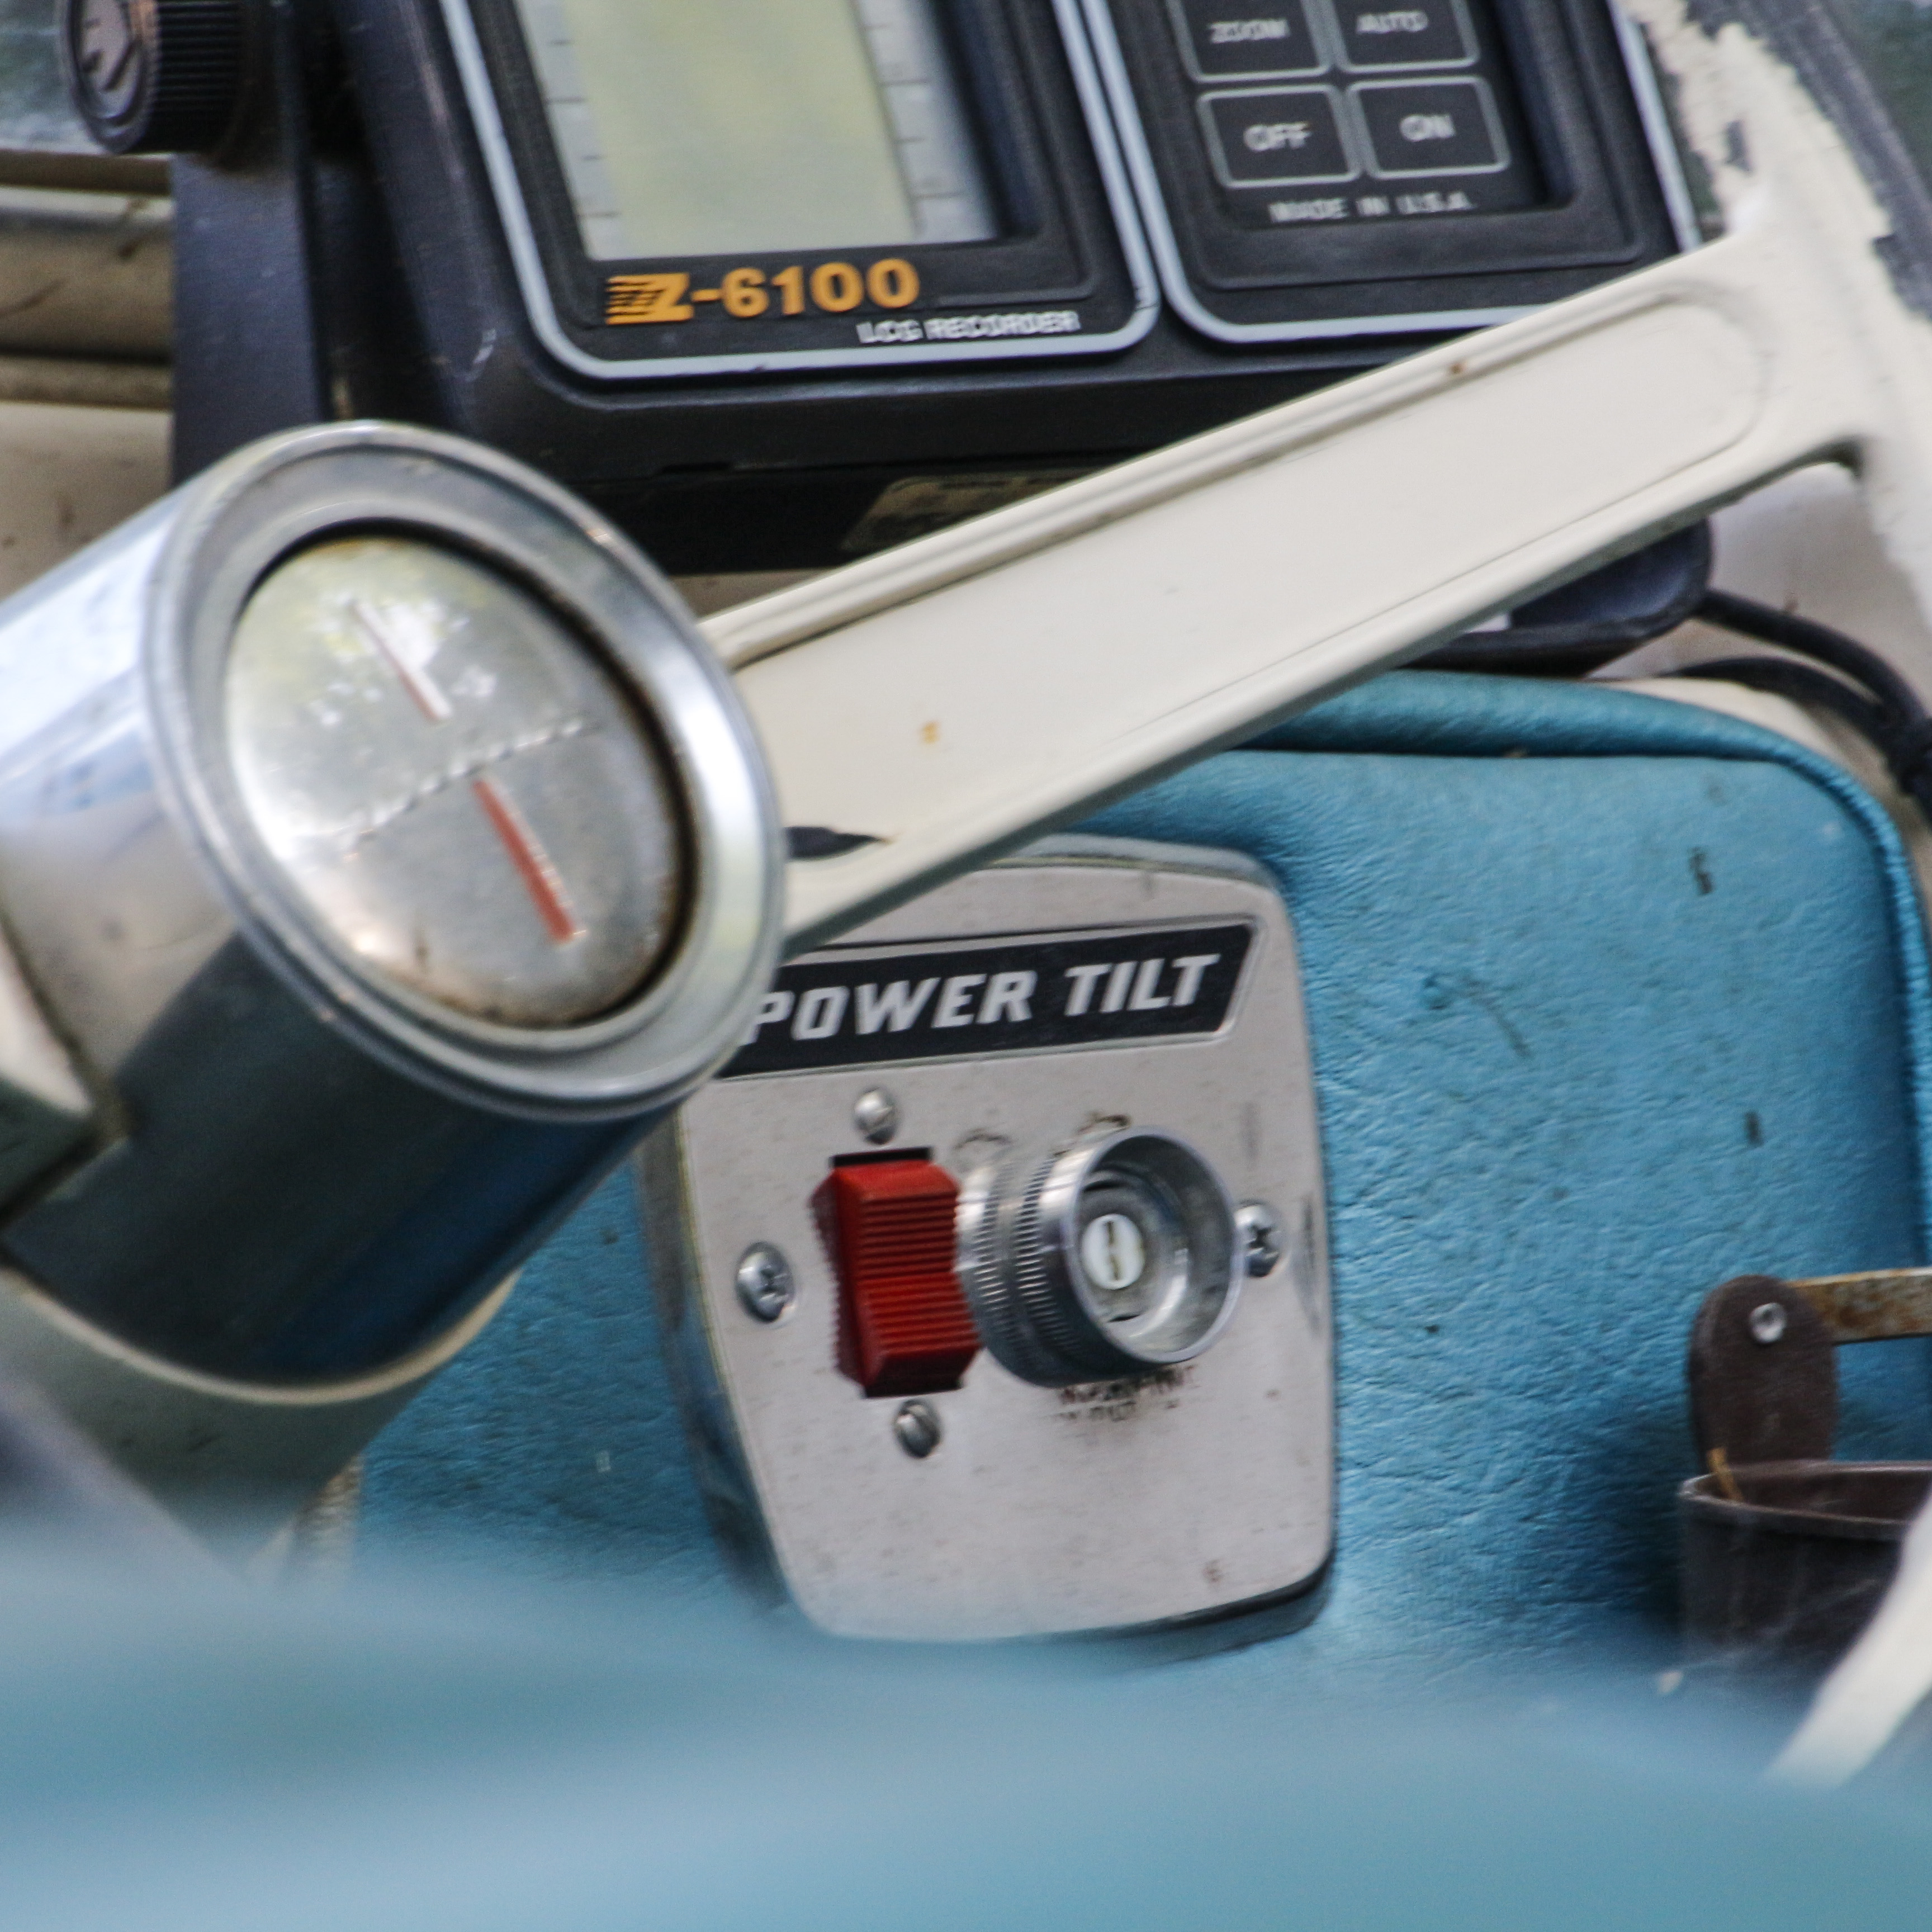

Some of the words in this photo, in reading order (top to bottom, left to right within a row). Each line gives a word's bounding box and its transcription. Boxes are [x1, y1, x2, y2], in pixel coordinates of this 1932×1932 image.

[1209, 18, 1290, 44] ZOOM
[1356, 10, 1428, 34] AUTO
[1244, 122, 1311, 151] OFF
[1399, 115, 1455, 143] ON
[1268, 198, 1349, 222] MADE
[1357, 195, 1390, 216] IN
[605, 258, 920, 324] Z-6100
[924, 310, 1081, 340] RECORDER
[742, 971, 1038, 1044] POWER
[1064, 954, 1220, 1017] TILT
